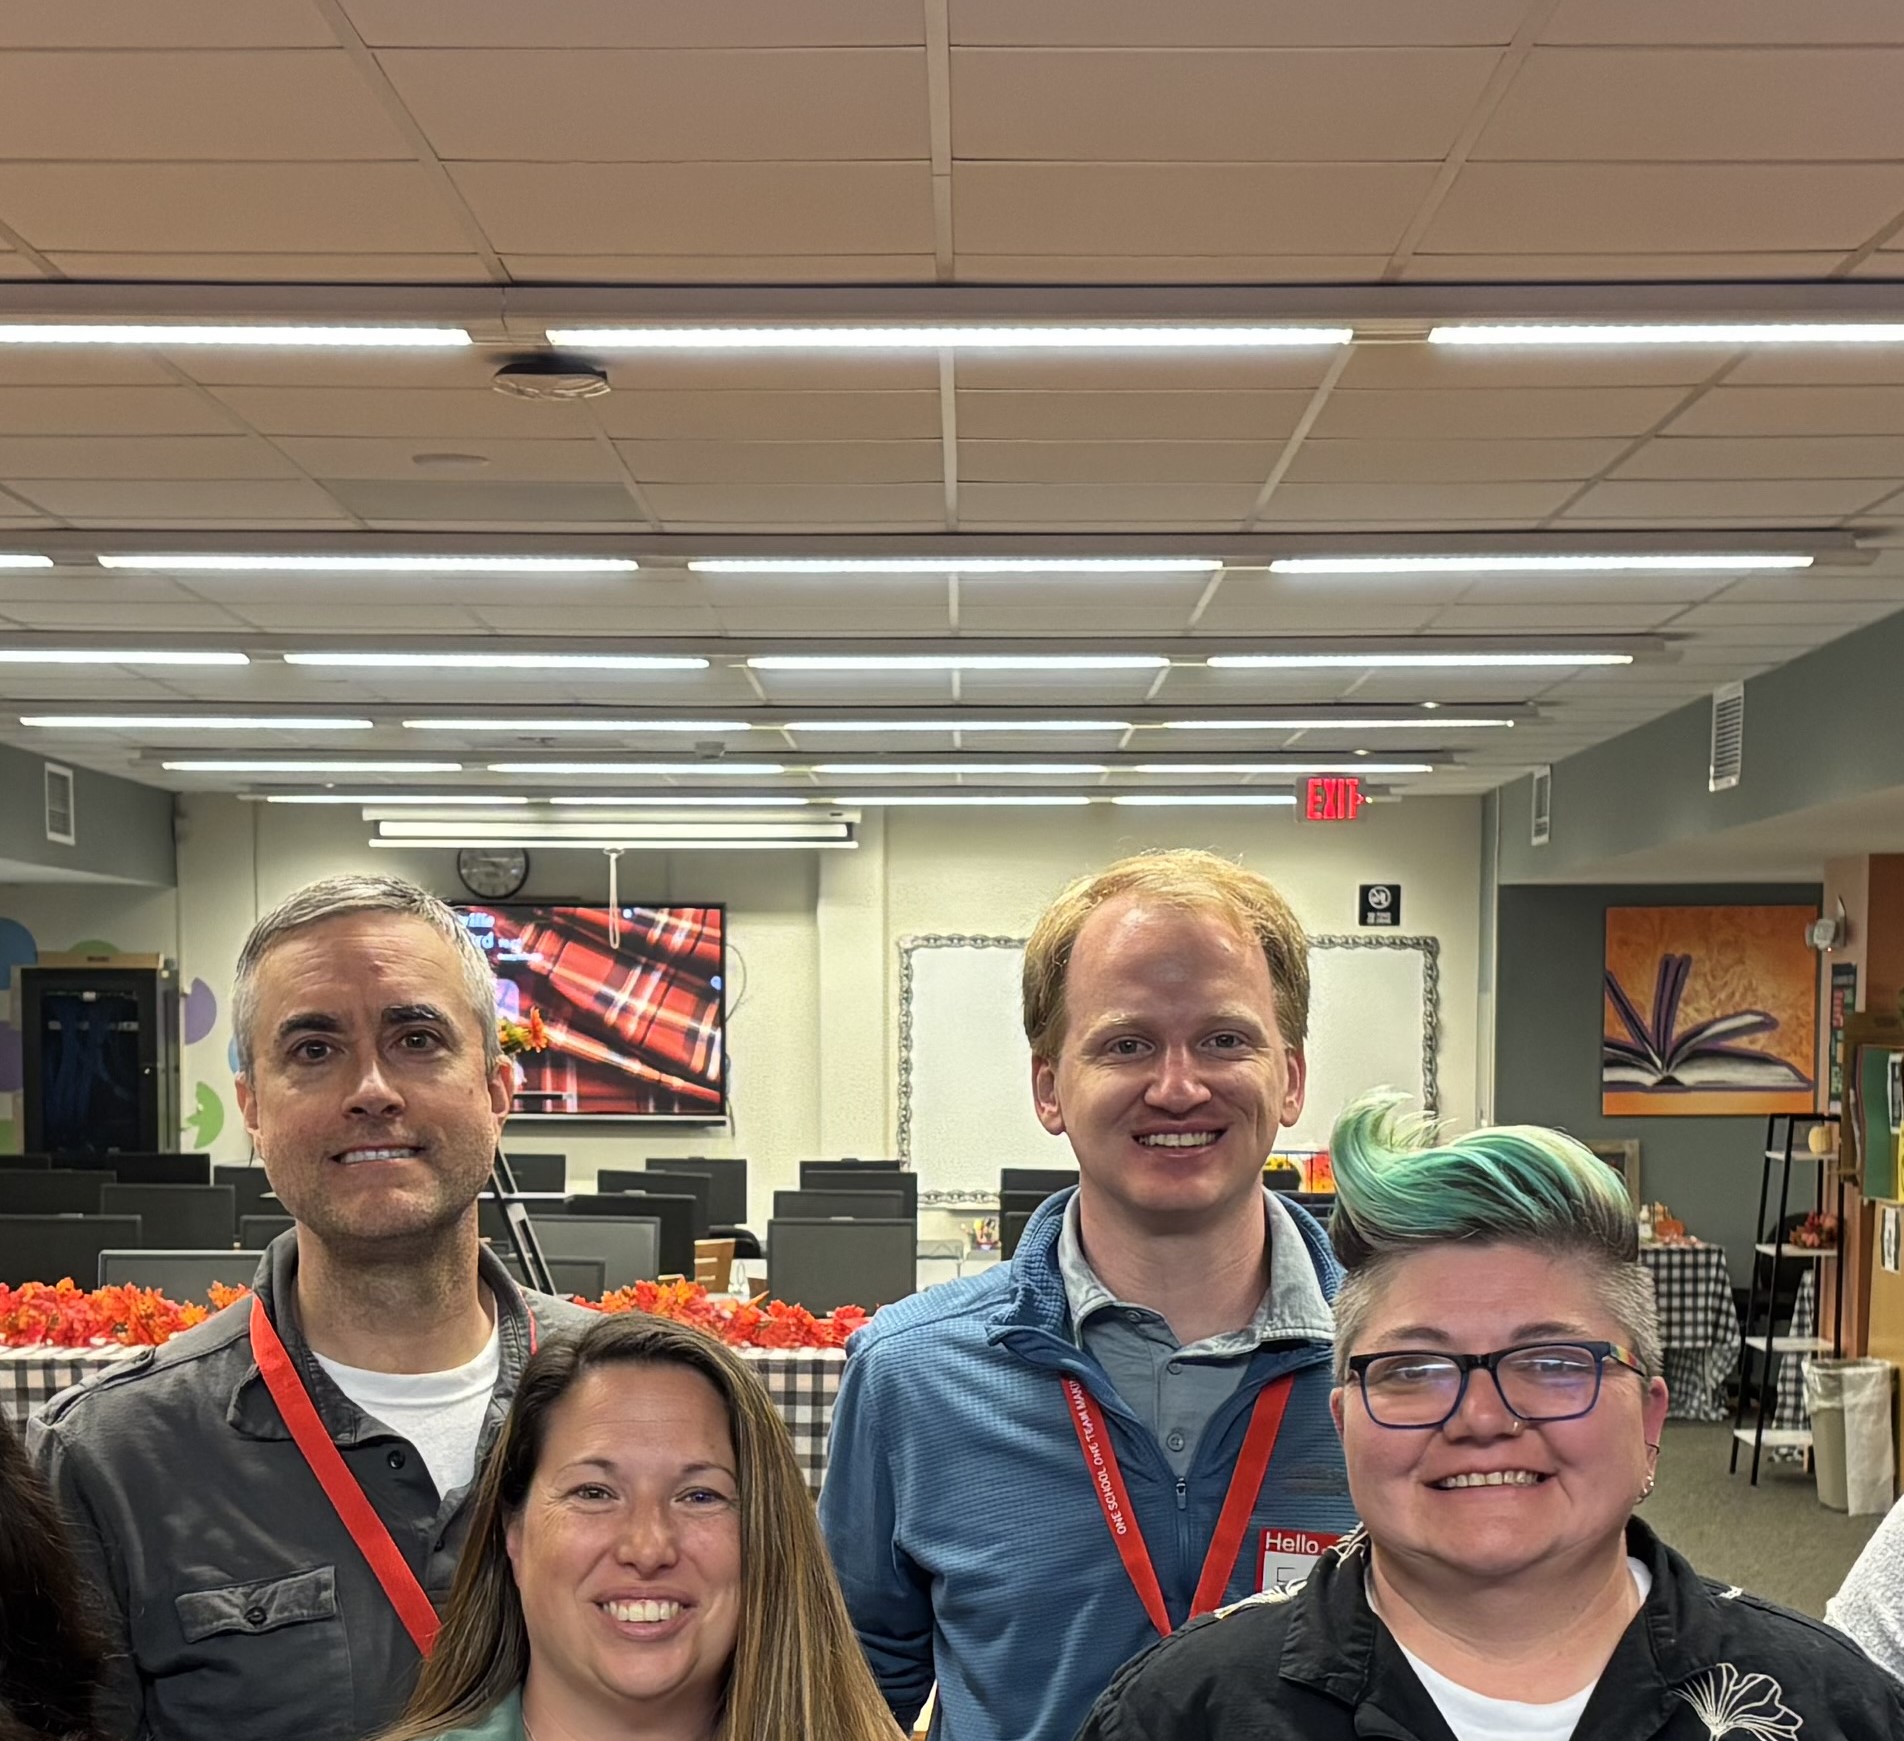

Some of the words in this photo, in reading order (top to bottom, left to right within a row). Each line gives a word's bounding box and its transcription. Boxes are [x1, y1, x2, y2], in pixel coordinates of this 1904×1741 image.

[1307, 778, 1359, 820] EXIT
[1078, 1410, 1096, 1443] TEAM
[1088, 1444, 1104, 1465] ONE
[1096, 1466, 1119, 1510] SCHOOL
[1110, 1509, 1127, 1535] ONE
[1265, 1531, 1319, 1554] Hello
